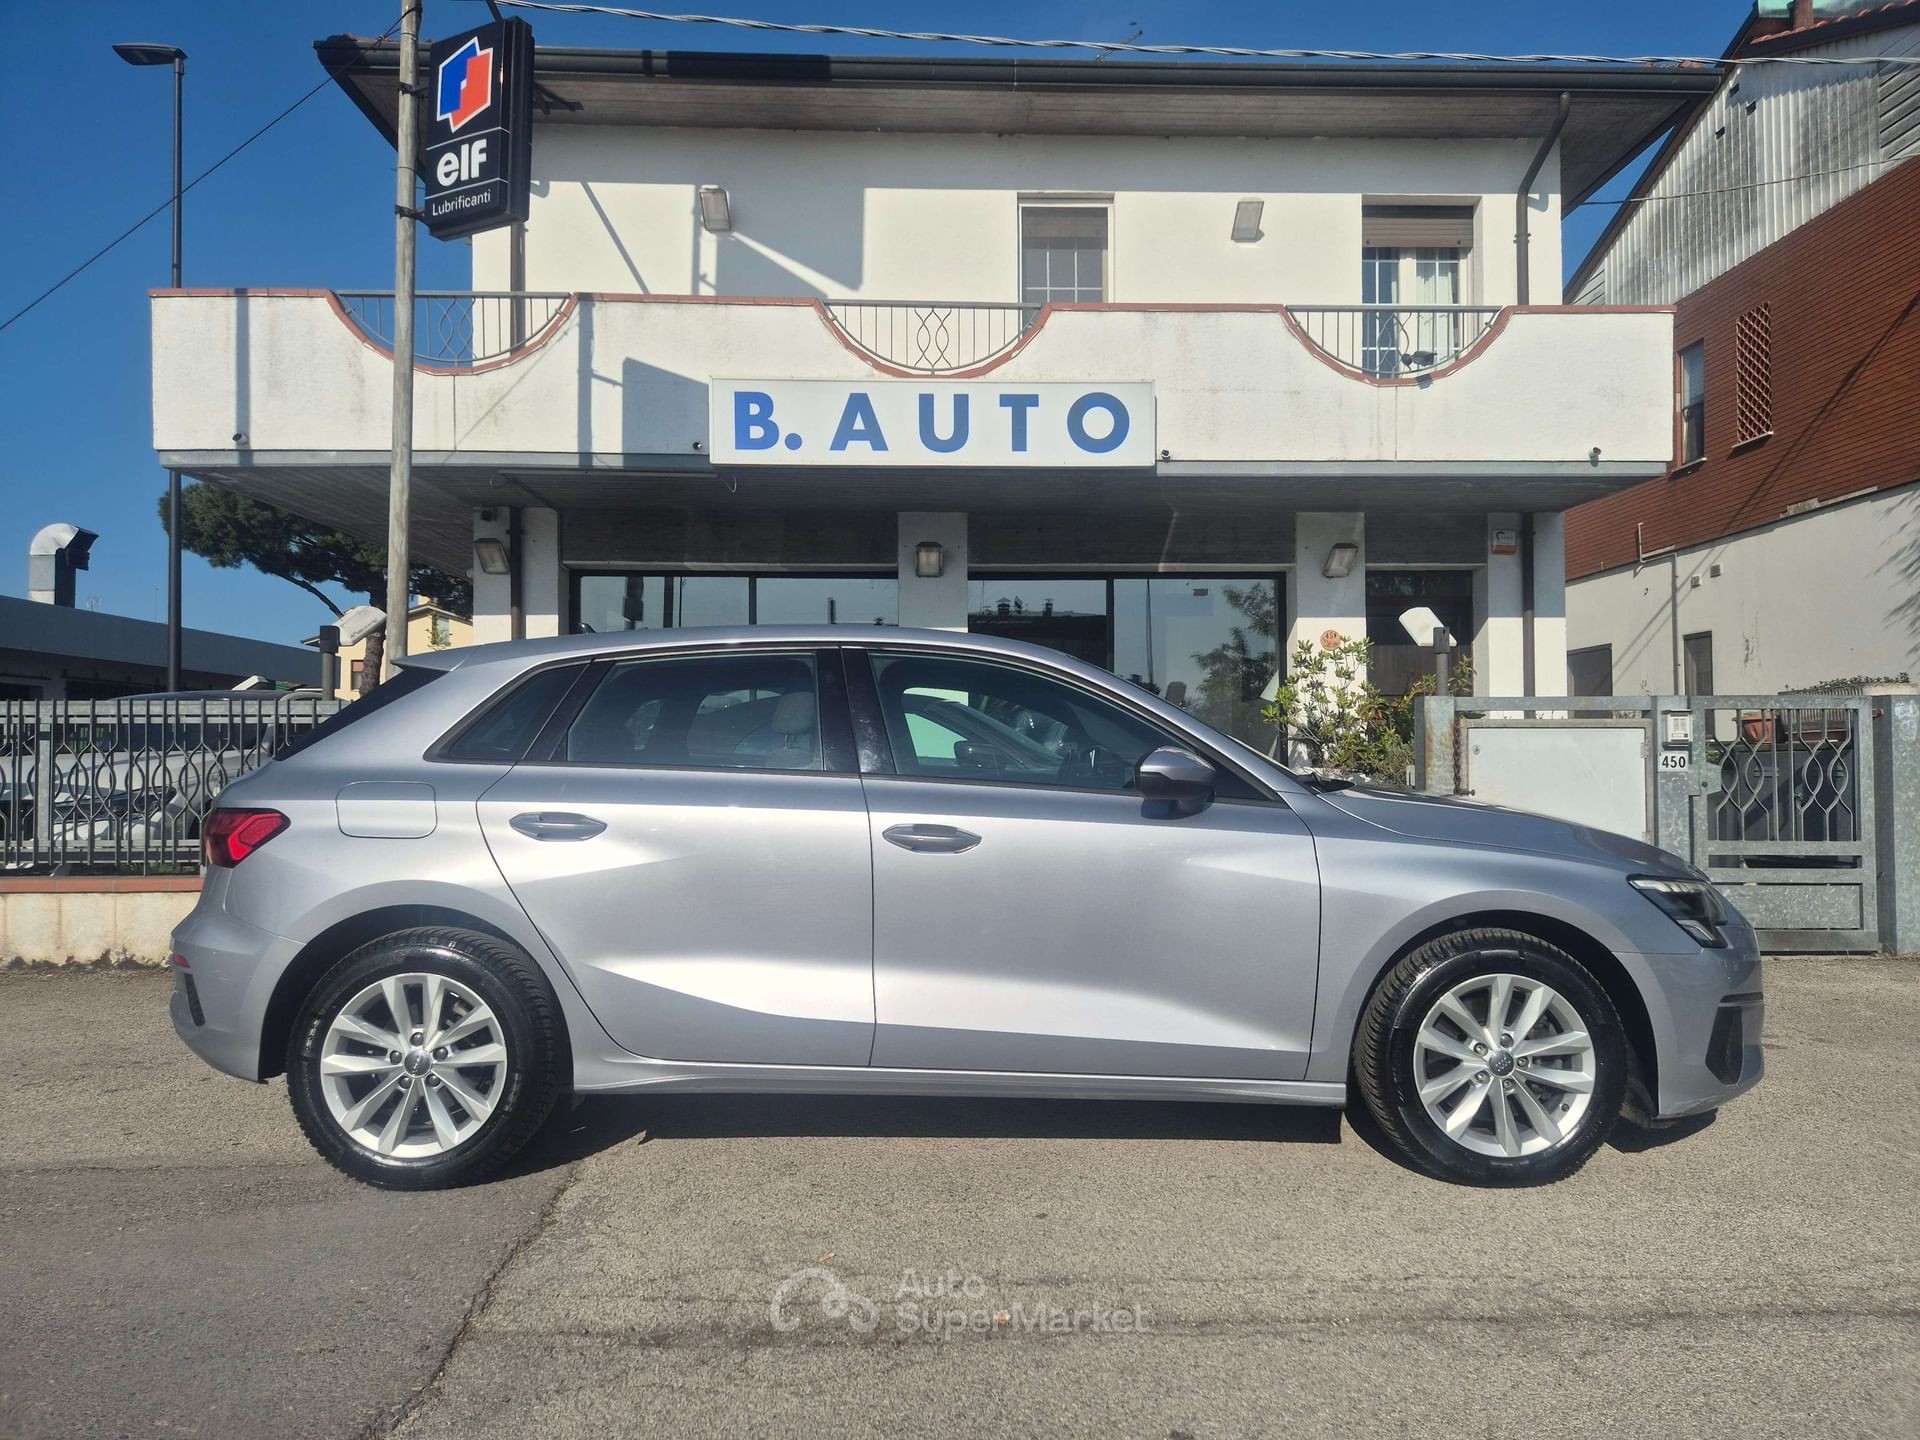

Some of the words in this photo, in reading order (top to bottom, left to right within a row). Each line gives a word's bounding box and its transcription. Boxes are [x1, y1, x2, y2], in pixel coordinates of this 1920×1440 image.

[437, 139, 487, 187] elf
[432, 189, 491, 216] Lubrificanti
[734, 391, 803, 451] B.
[829, 392, 1130, 454] AUTO
[1662, 755, 1686, 768] 450
